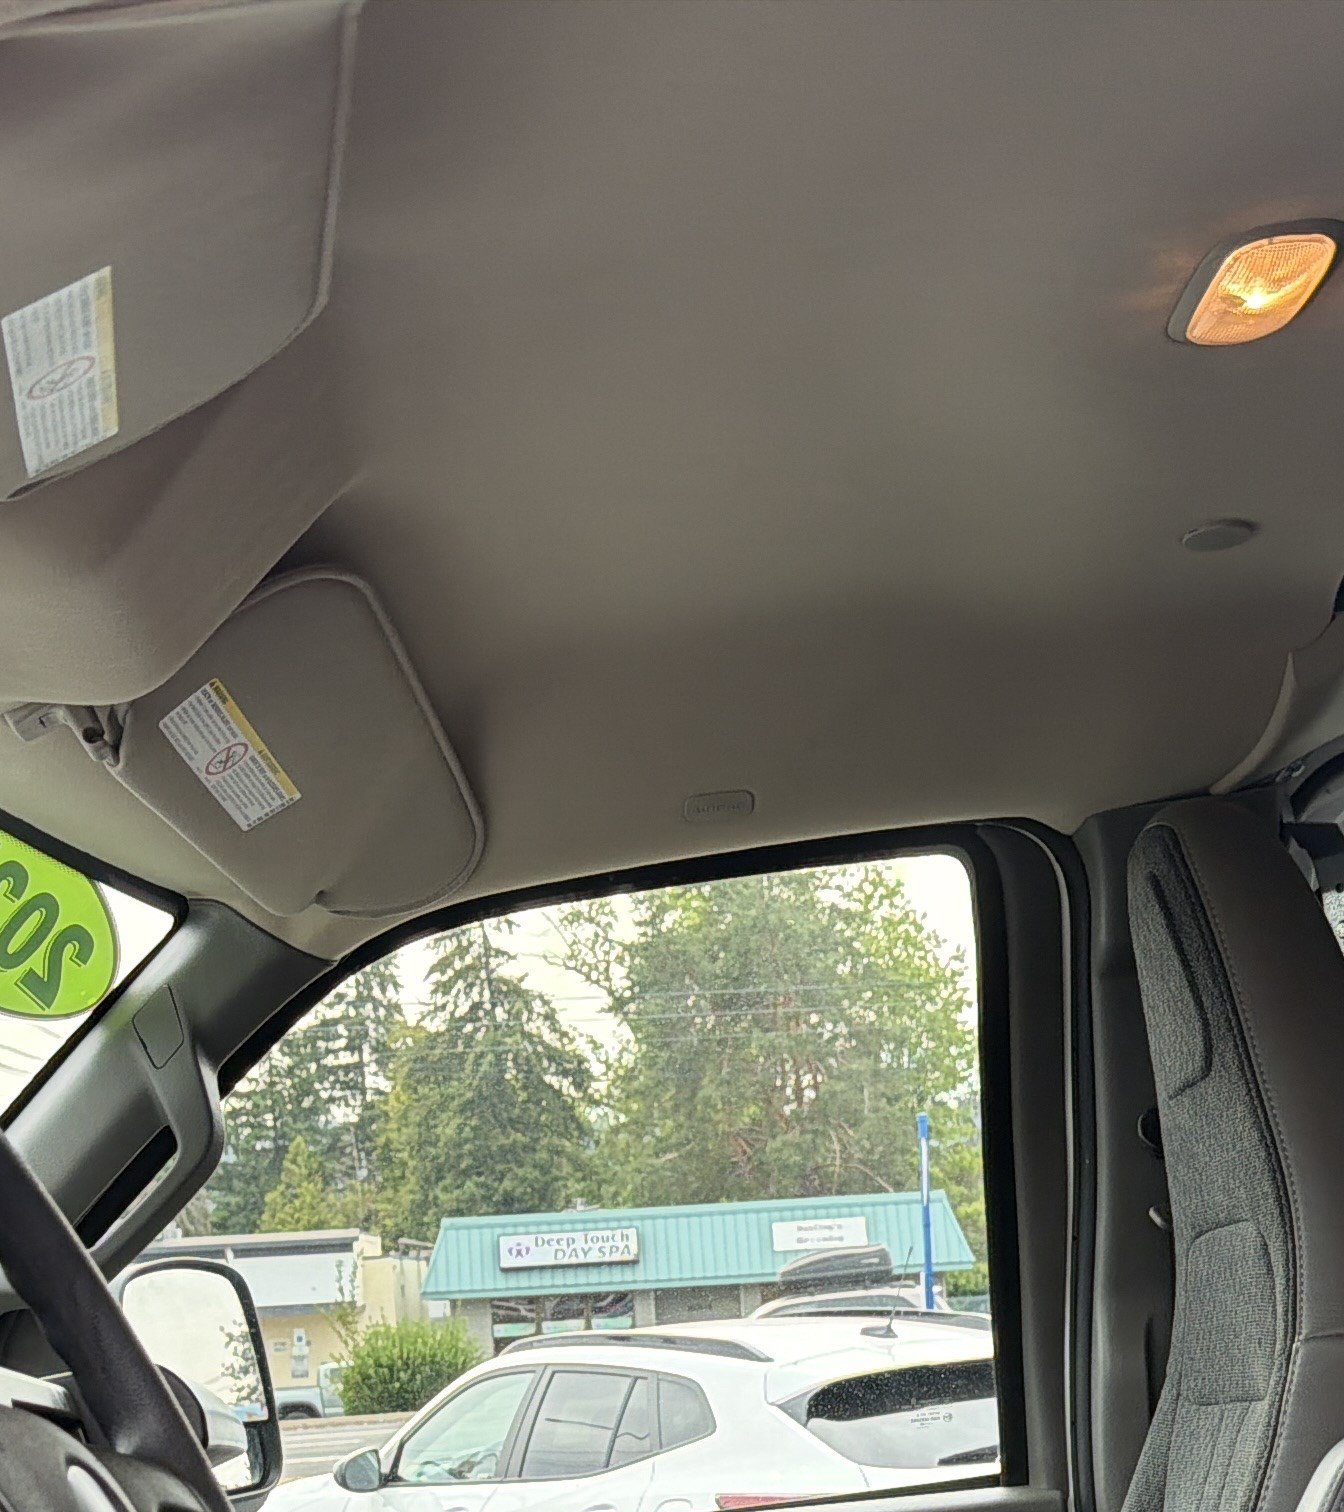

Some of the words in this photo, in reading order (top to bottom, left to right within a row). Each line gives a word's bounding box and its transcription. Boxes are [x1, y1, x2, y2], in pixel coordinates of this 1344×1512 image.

[534, 1235, 576, 1249] Deep
[583, 1230, 630, 1245] Touch
[554, 1247, 593, 1261] DAY
[597, 1244, 632, 1259] SPA
